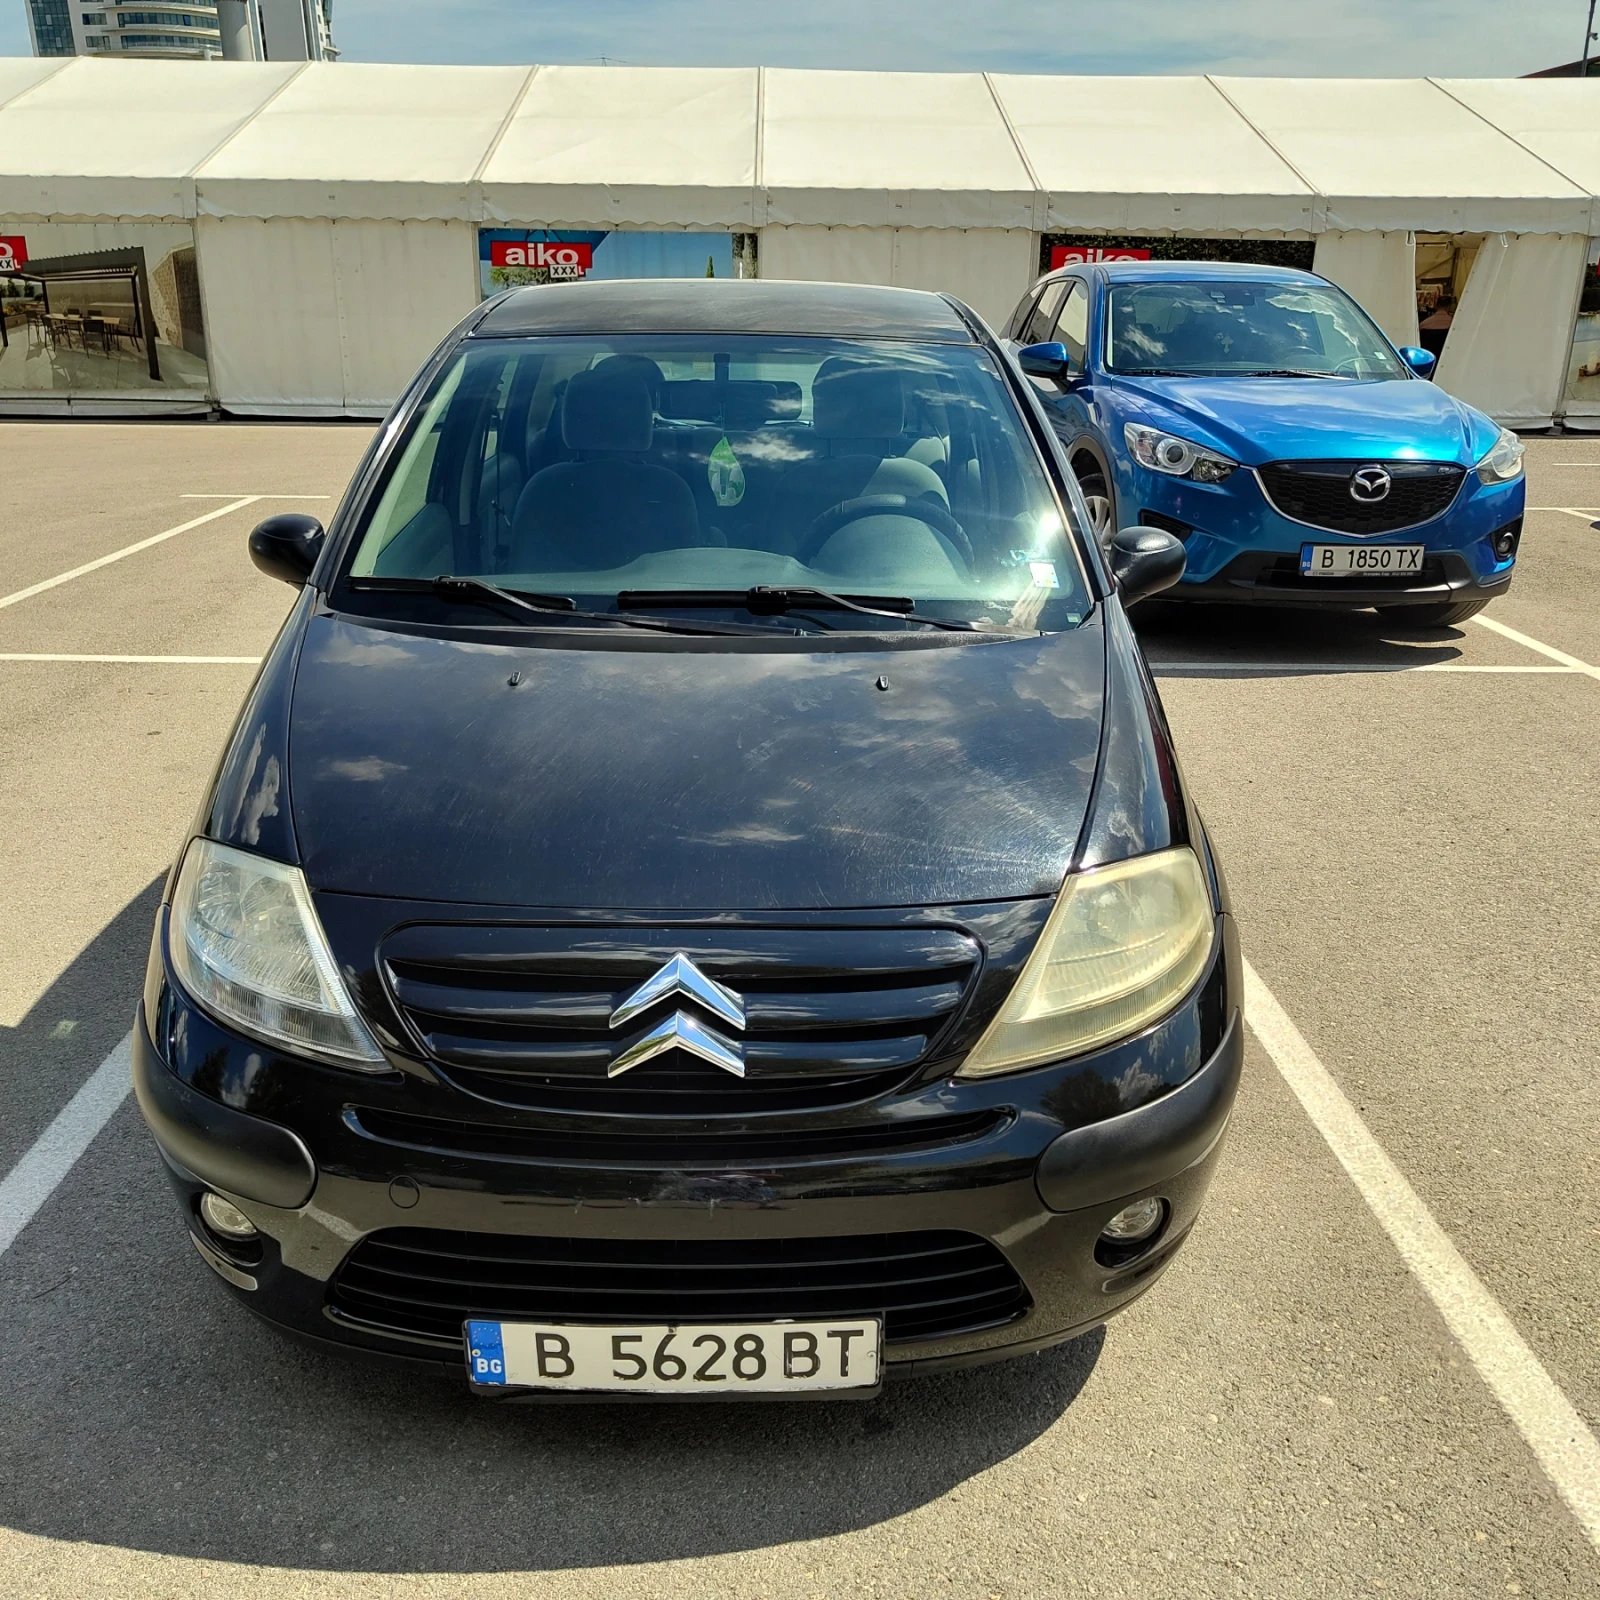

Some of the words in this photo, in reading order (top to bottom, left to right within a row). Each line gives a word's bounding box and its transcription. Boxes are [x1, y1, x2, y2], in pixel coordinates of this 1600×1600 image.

[505, 243, 579, 265] aiko
[1321, 549, 1334, 568] B
[1348, 549, 1391, 568] 1850
[1396, 549, 1420, 568] TX
[535, 1332, 575, 1378] B
[612, 1333, 767, 1381] 5628
[783, 1329, 864, 1379] BT
[476, 1358, 502, 1374] BG
